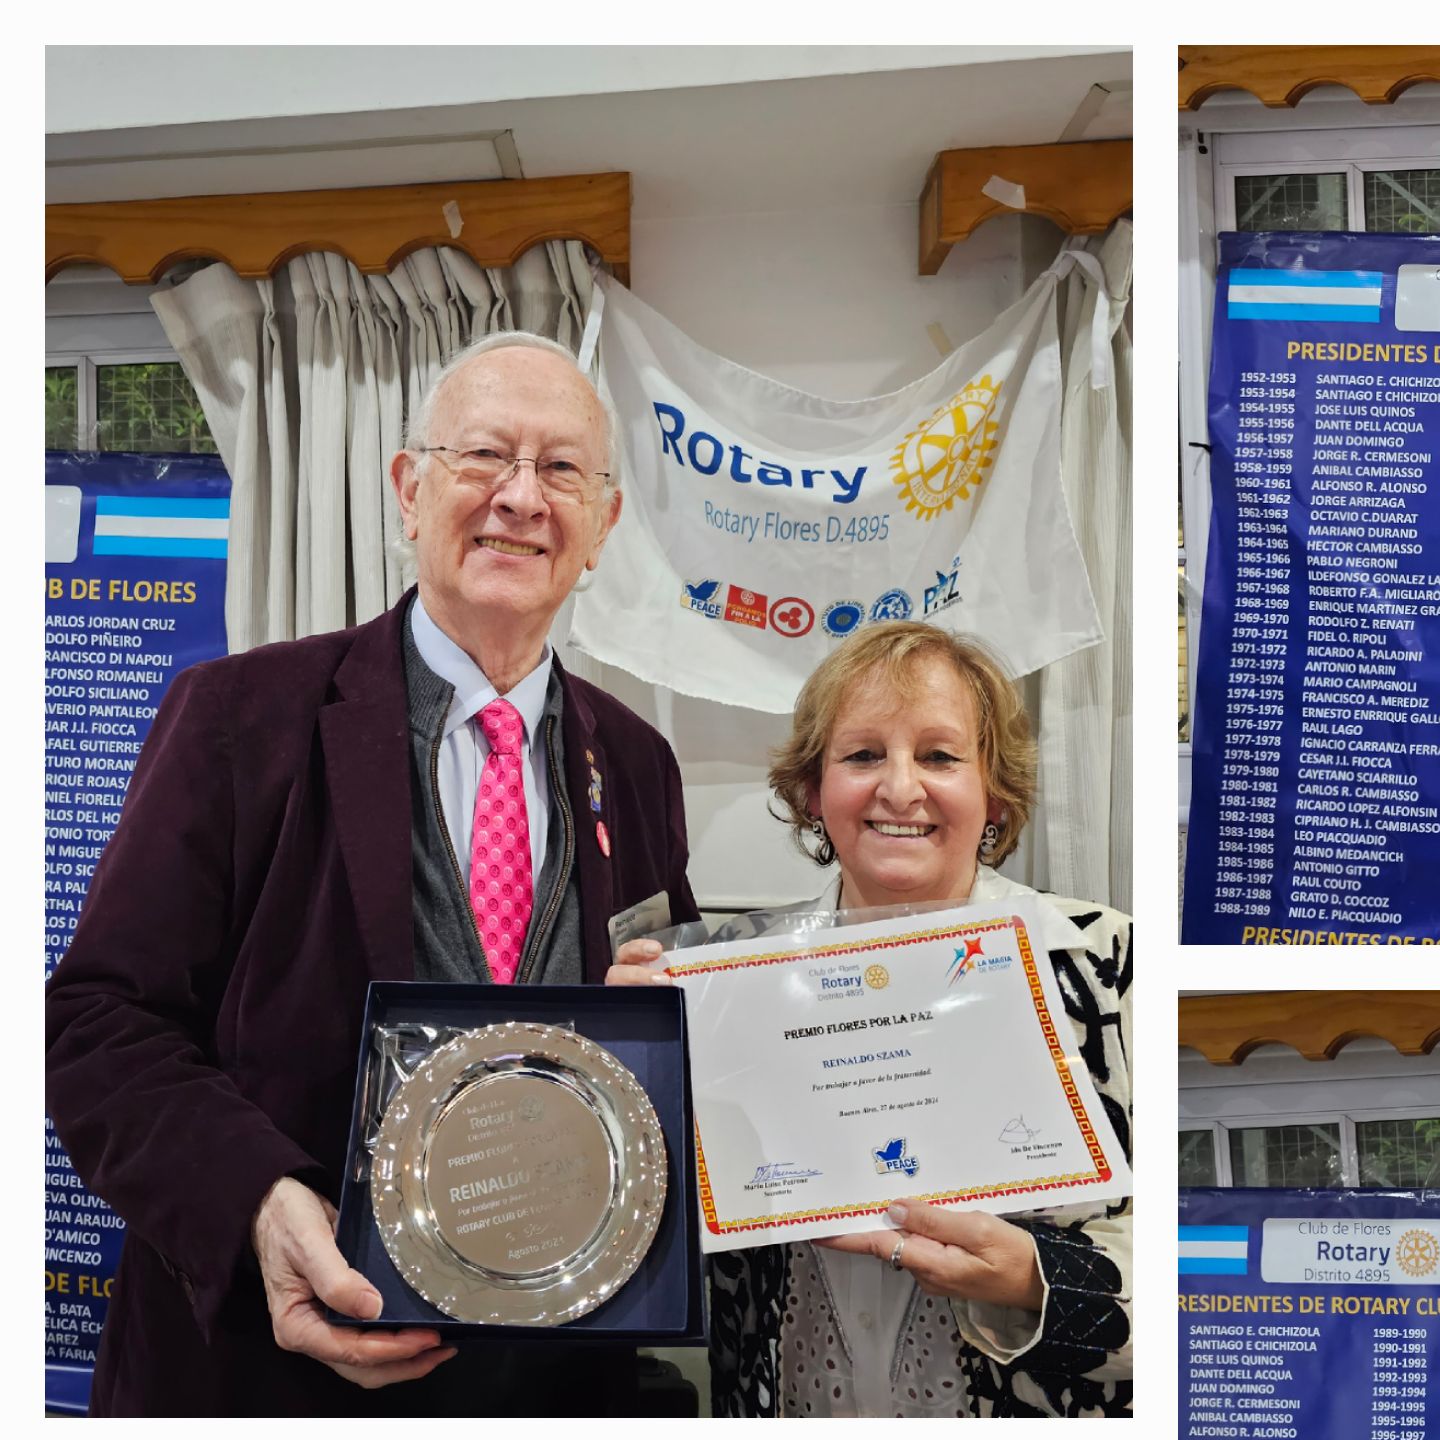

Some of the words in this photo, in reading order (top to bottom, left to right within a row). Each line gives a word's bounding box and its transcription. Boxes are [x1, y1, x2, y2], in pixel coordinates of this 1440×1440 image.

[1287, 341, 1427, 364] PRESIDENTES
[1241, 372, 1296, 384] 1952-1953
[1316, 374, 1374, 386] SANTIAGO
[1376, 376, 1387, 387] E.
[653, 401, 868, 503] Rotary
[704, 501, 759, 539] Rotary
[764, 512, 821, 542] Flores
[826, 514, 890, 542] D.4895
[71, 579, 101, 600] DE
[109, 579, 196, 603] FLORES
[691, 598, 721, 617] PEACE
[88, 616, 139, 629] JORDAN
[142, 618, 175, 631] CRUZ
[91, 630, 142, 647] PIÑEIRO
[109, 652, 122, 665] DI
[125, 652, 172, 666] NAPOLI
[96, 669, 163, 683] ROMANELI
[88, 686, 149, 700] SICILIANO
[1214, 903, 1270, 916] 1988-1989
[1288, 907, 1317, 919] NILO
[1319, 909, 1329, 920] E.
[1331, 911, 1402, 924] PIACQUADIO
[822, 974, 862, 990] Rotary
[784, 1025, 824, 1040] PREMIO
[826, 1020, 867, 1035] FLORES
[869, 1017, 891, 1029] POR
[894, 1014, 908, 1025] LA
[910, 1011, 934, 1023] PAZ
[823, 1055, 874, 1068] REINALDO
[877, 1049, 911, 1060] SZAMA
[469, 1110, 513, 1130] Rotary
[448, 1151, 485, 1168] PREMIO
[887, 1158, 917, 1171] PEACE
[449, 1169, 530, 1203] REINALDO
[1298, 1222, 1329, 1236] Club
[1332, 1223, 1349, 1236] de
[1353, 1223, 1391, 1236] Flores
[1316, 1241, 1391, 1265] Rotary
[1304, 1268, 1351, 1282] Distrito
[1355, 1268, 1391, 1282] 4895
[1299, 1296, 1325, 1313] DE
[1331, 1296, 1410, 1315] ROTARY
